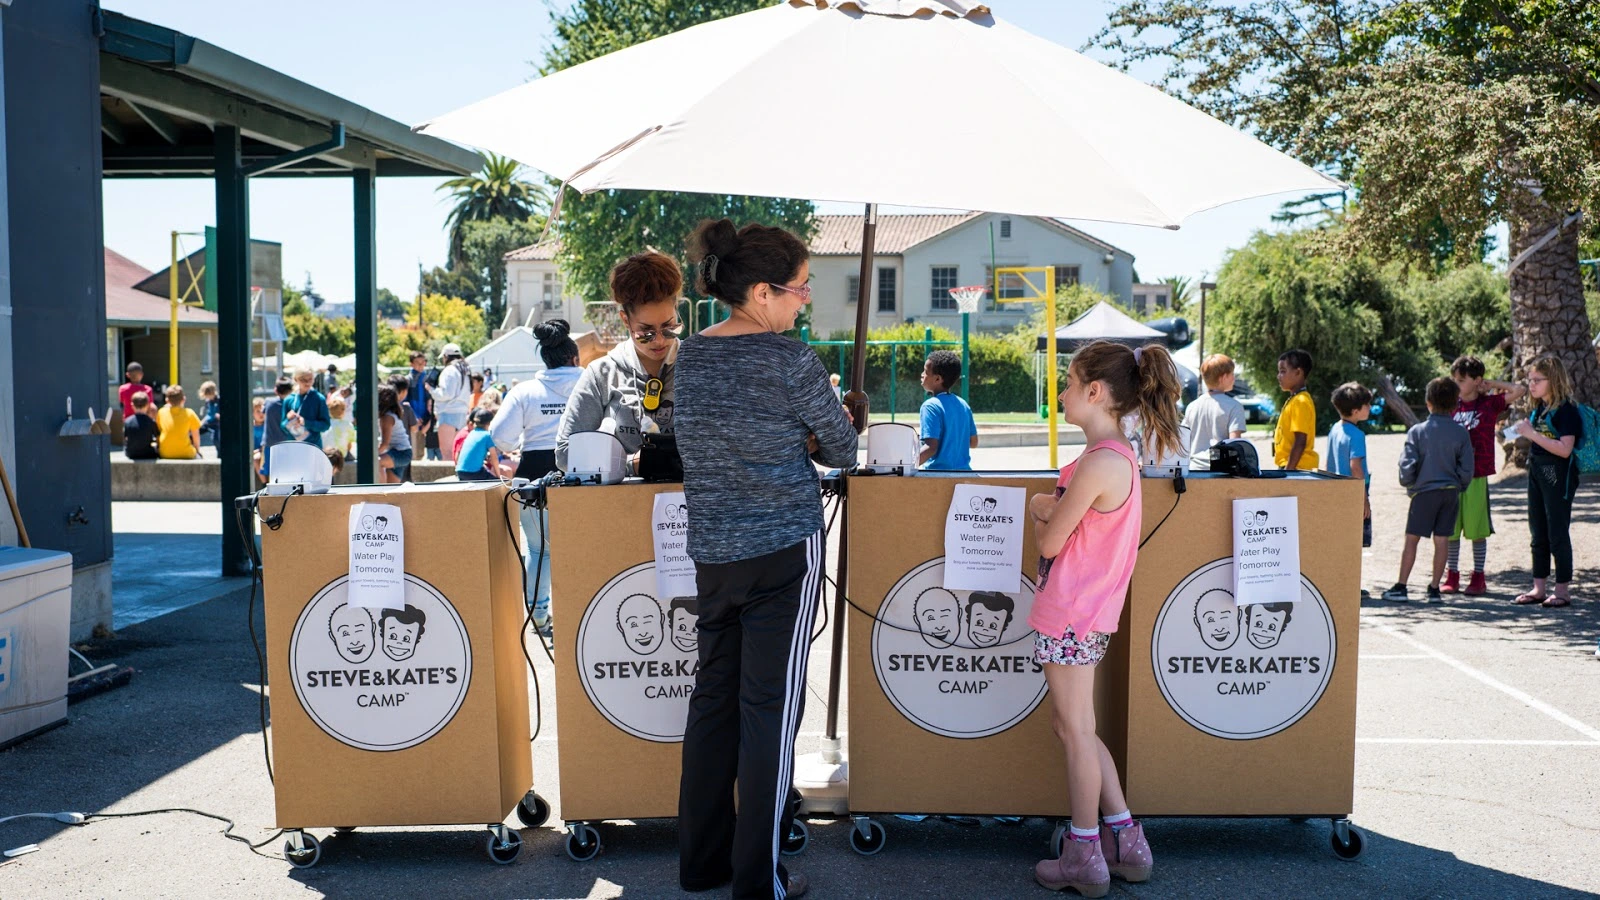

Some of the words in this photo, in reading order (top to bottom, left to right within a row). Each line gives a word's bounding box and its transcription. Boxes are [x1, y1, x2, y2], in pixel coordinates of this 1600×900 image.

[954, 514, 1013, 524] STEVE&KATE'S
[657, 522, 688, 530] STEVE&K
[1242, 527, 1287, 536] VE&KATE'S
[987, 535, 1005, 544] Play
[960, 546, 1004, 556] Tomorrow
[1262, 547, 1280, 556] Play
[380, 552, 394, 562] Play
[1240, 562, 1280, 570] Tomorrow
[888, 654, 1043, 673] STEVE&KATE'S
[1167, 656, 1320, 674] STEVE&KATE'S
[593, 659, 700, 679] STEVE&KA
[306, 667, 458, 688] STEVE&KATE'S
